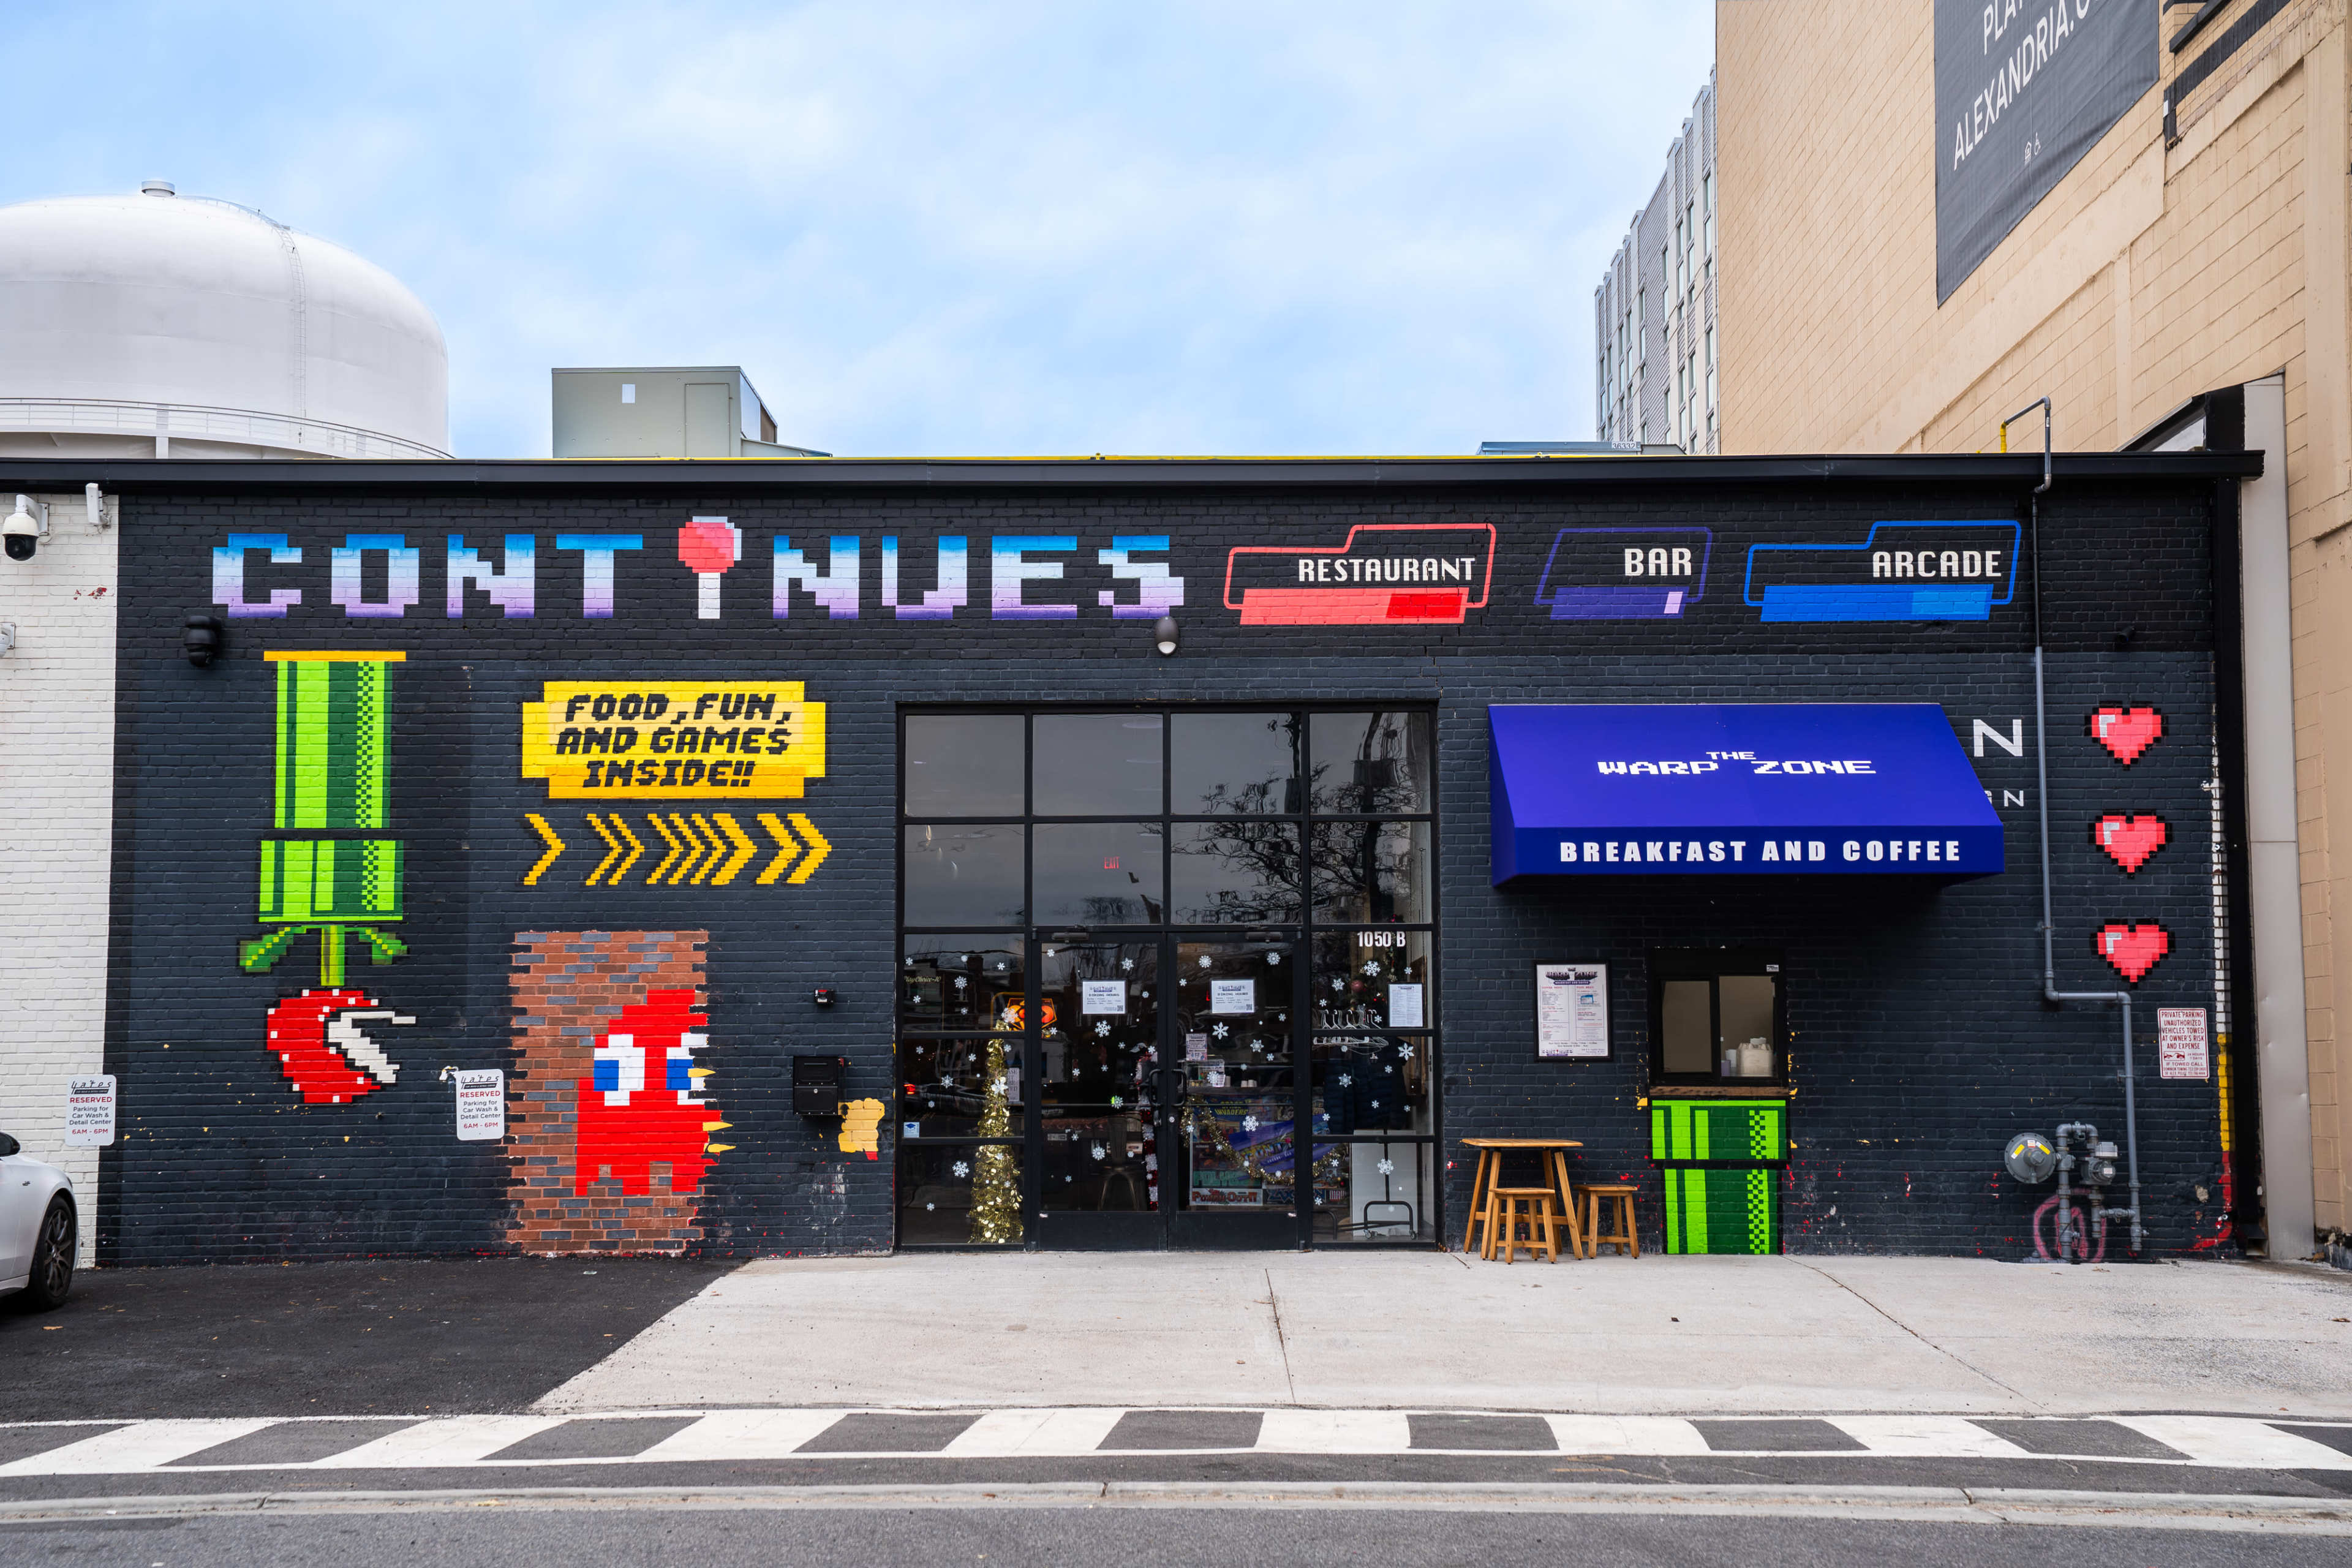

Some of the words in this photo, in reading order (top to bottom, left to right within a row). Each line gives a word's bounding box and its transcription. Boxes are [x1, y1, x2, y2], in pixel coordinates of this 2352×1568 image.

[1984, 0, 2022, 56] PLA
[1298, 557, 1476, 582] RESTAURANT
[1624, 548, 1692, 576] BAR
[1872, 551, 2001, 578] ARCADE
[556, 727, 639, 755] AND
[649, 726, 792, 755] GAMES
[1597, 761, 1719, 775] WARP
[1751, 760, 1877, 774] ZONE
[1706, 752, 1756, 760] THE
[583, 760, 755, 788] INSIDE!!
[1560, 841, 1746, 862] BREAKFAST
[1762, 841, 1826, 862] AND
[1843, 840, 1961, 862] COFFEE
[1357, 931, 1392, 947] 1050
[1396, 931, 1406, 947] B
